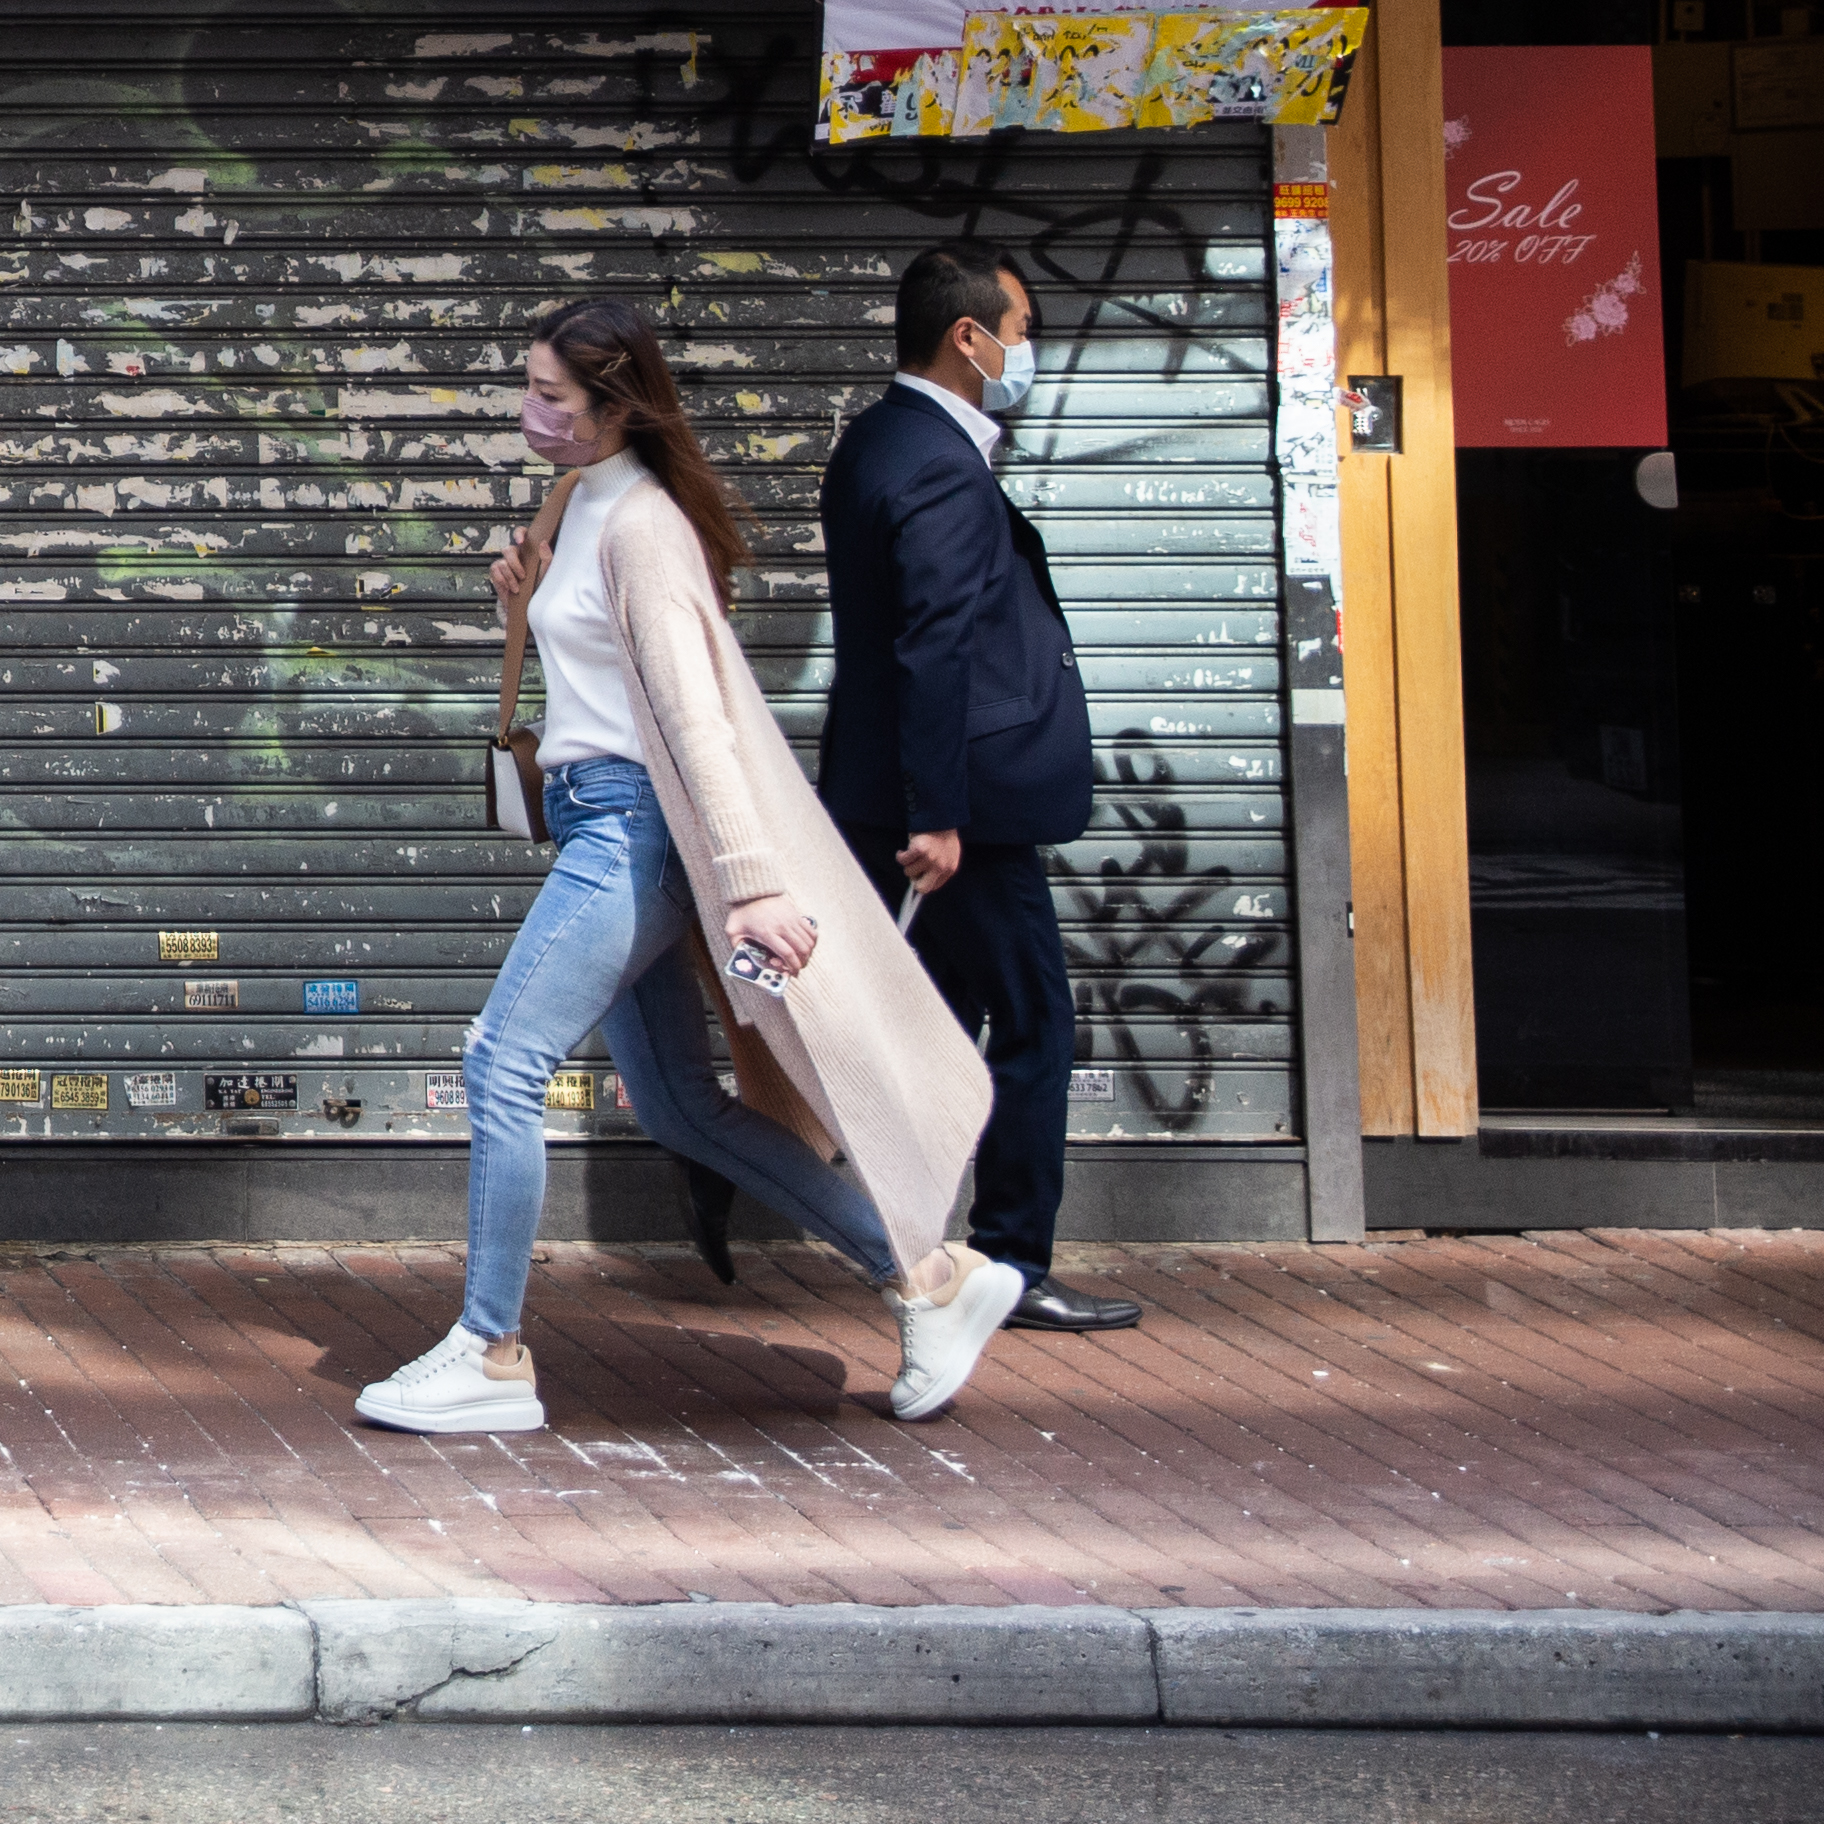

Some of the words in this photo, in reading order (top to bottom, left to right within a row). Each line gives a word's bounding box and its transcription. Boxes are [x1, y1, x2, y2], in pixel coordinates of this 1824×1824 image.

[1447, 170, 1582, 230] Sale
[1446, 237, 1501, 264] 20%
[1514, 234, 1596, 264] OFF
[166, 937, 189, 954] 5508
[190, 937, 213, 954] 8393
[60, 1091, 79, 1103] 6545
[80, 1091, 100, 1103] 3859
